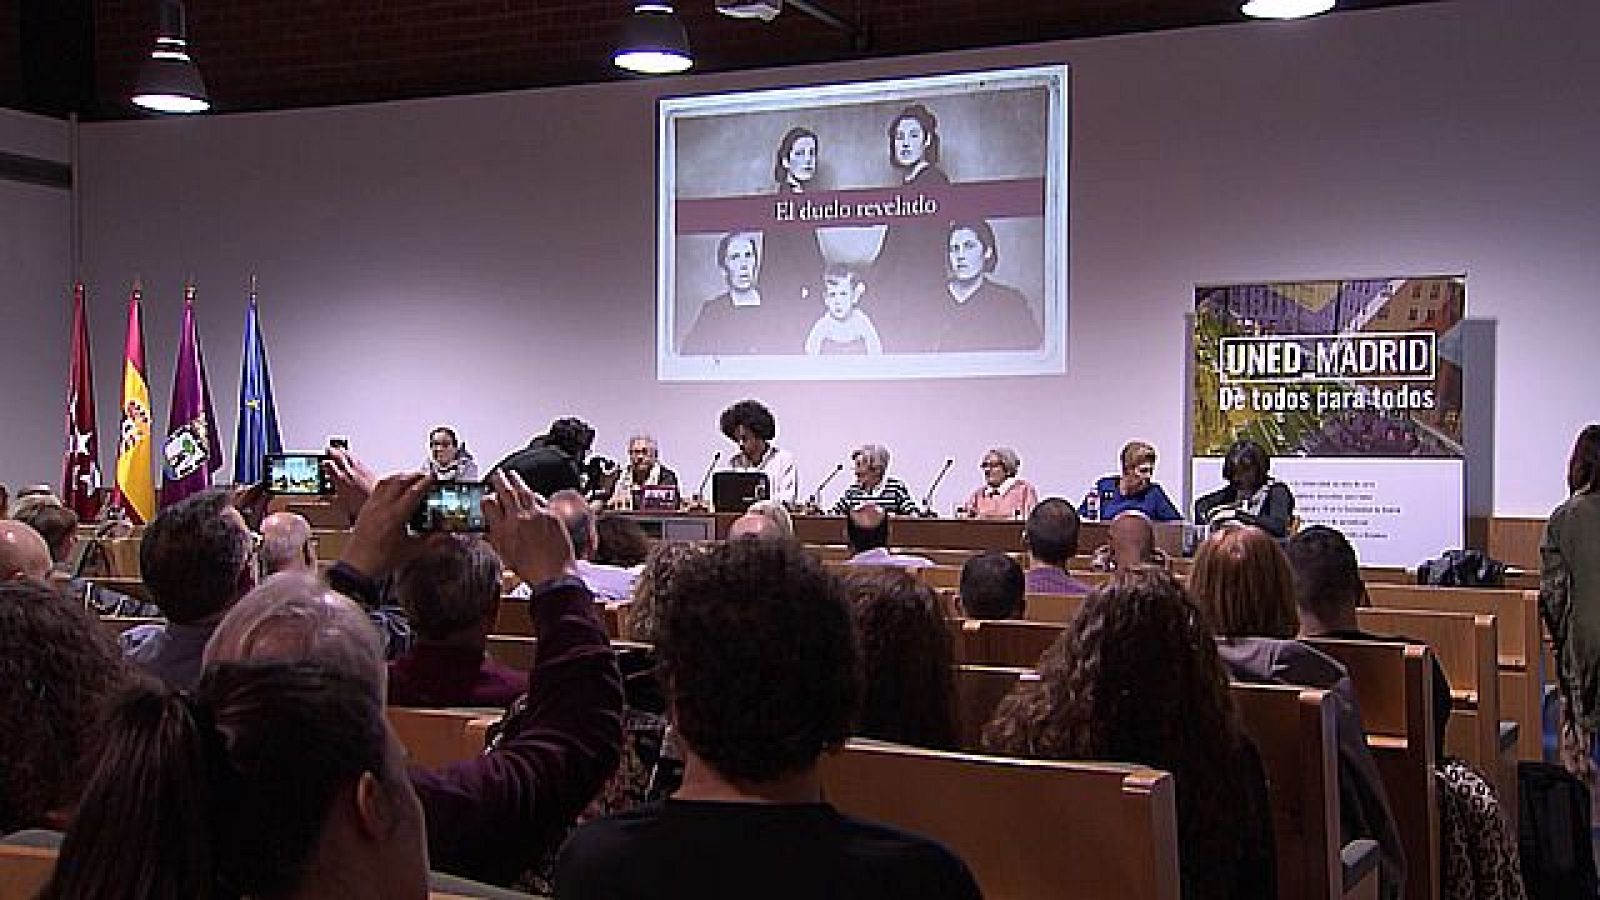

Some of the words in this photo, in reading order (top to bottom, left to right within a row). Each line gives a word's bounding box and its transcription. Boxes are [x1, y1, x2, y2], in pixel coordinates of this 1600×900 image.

[776, 201, 794, 221] El
[799, 200, 851, 220] duelo
[857, 195, 937, 216] revelado
[1220, 386, 1246, 411] De
[1252, 386, 1311, 410] todos
[1317, 388, 1367, 413] para
[1373, 384, 1434, 409] todos
